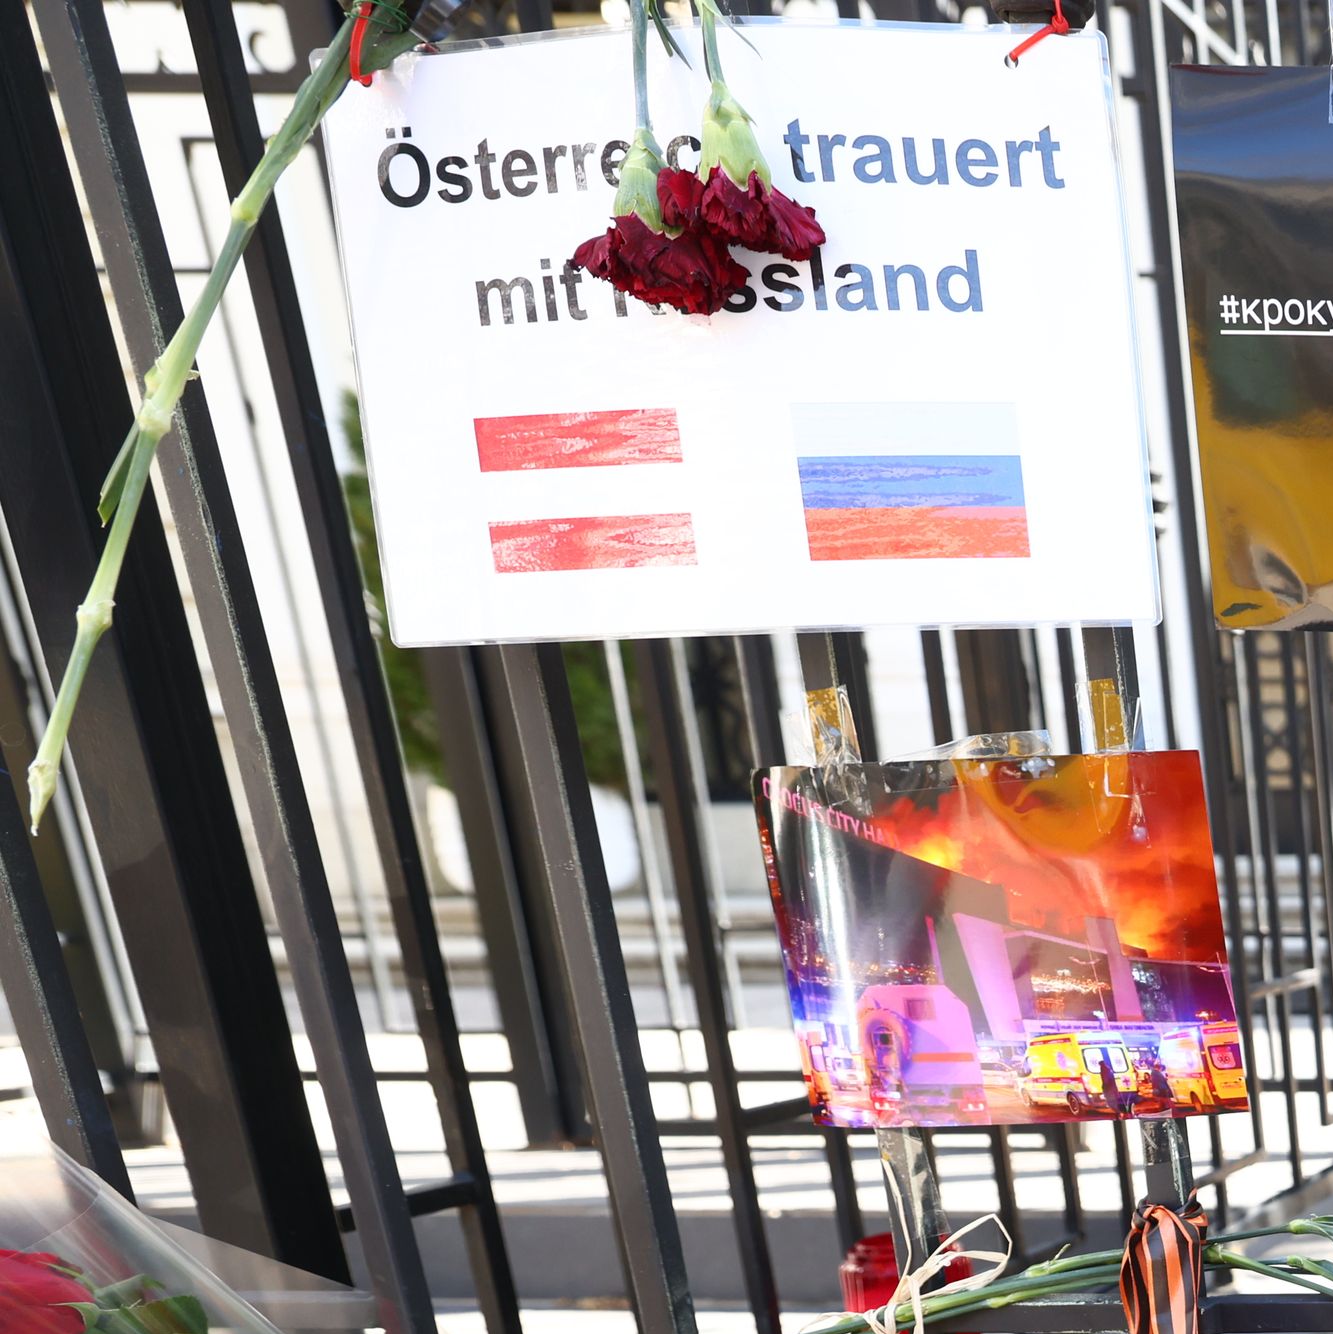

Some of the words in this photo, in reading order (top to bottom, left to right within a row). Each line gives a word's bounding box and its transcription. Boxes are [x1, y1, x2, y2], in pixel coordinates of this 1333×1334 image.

[377, 126, 701, 209] Österrec
[783, 118, 1065, 189] trauert
[475, 257, 588, 327] mit
[612, 247, 983, 319] ssland
[762, 777, 825, 824] COCUS
[826, 804, 861, 836] CITY
